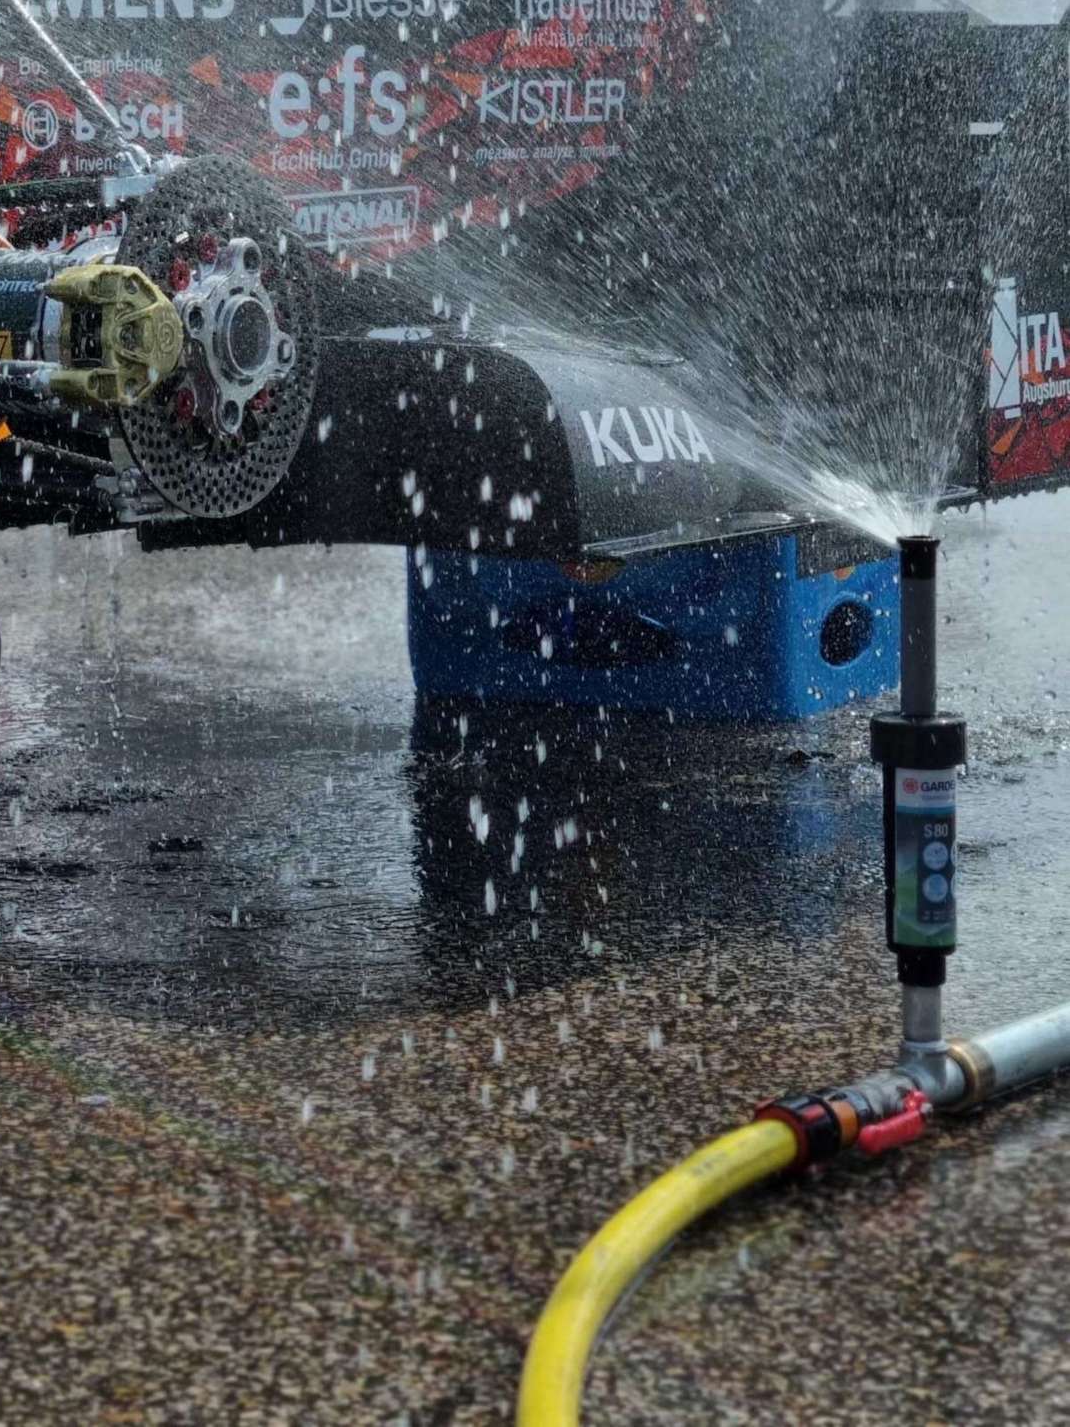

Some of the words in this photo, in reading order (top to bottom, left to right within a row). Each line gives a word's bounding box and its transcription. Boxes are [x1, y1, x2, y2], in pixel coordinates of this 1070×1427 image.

[72, 54, 163, 76] Engineering
[474, 78, 626, 124] KISTLER
[270, 151, 344, 171] TechHub
[349, 147, 403, 172] GmbH
[294, 199, 408, 234] ATIONAL
[1019, 312, 1066, 375] ITA
[580, 406, 715, 467] KUKA
